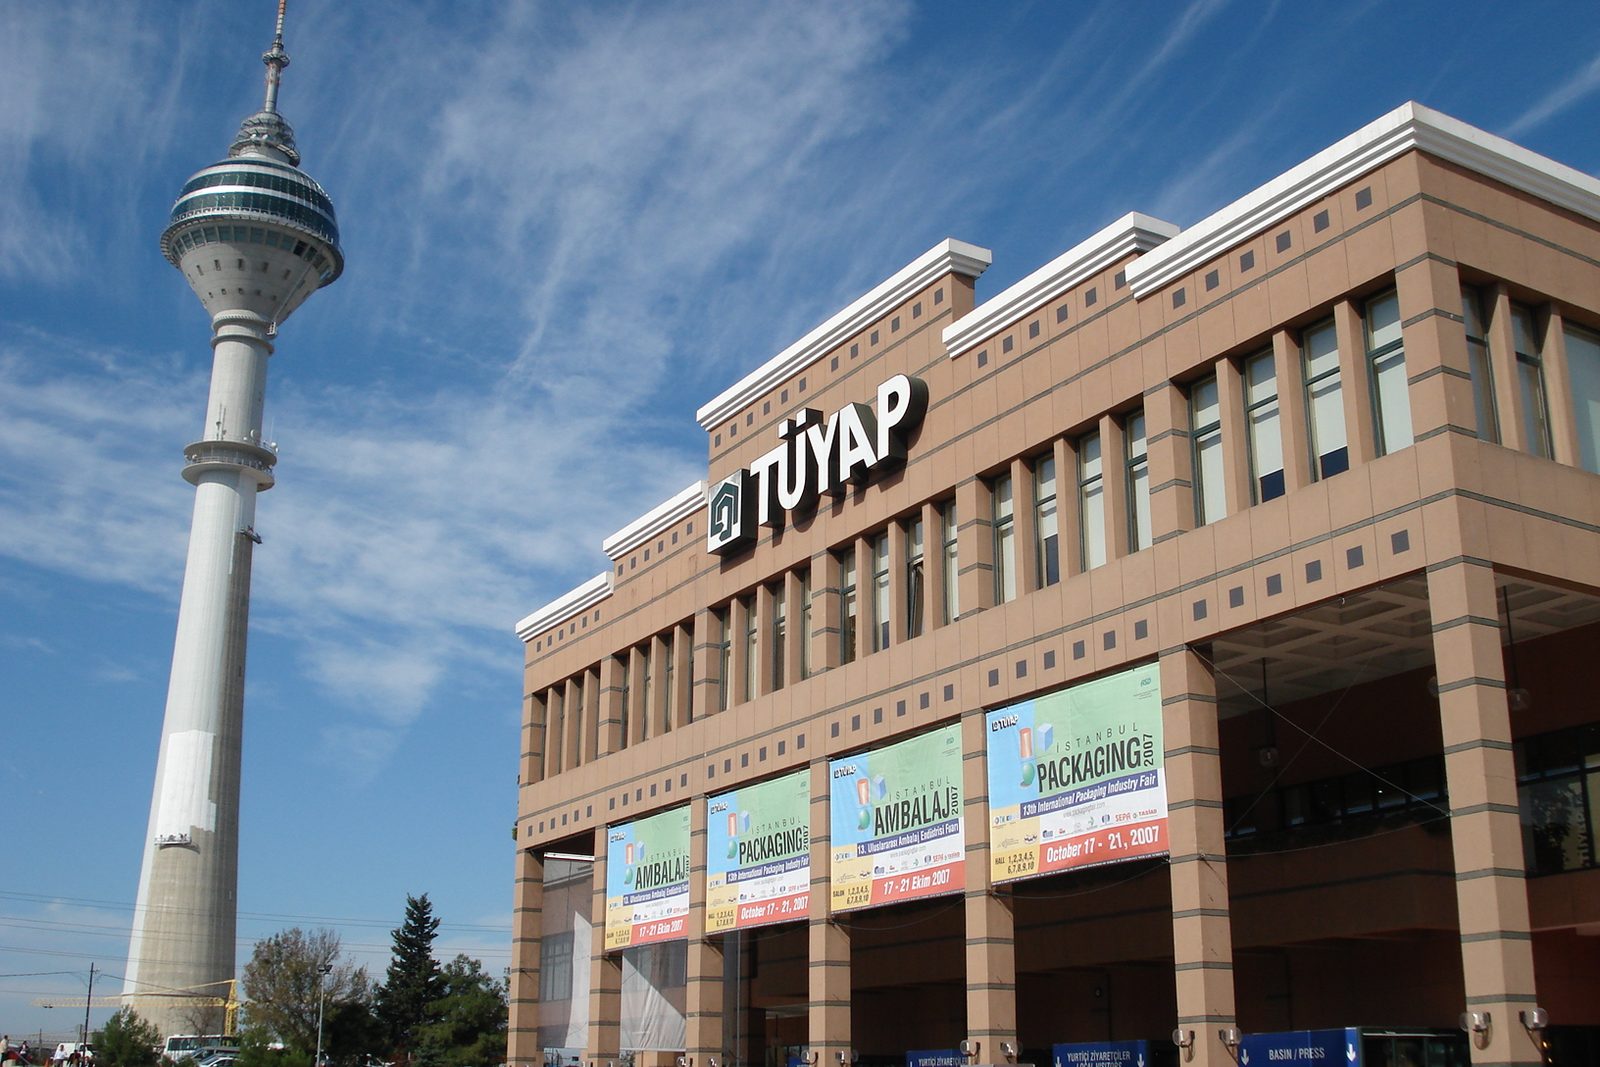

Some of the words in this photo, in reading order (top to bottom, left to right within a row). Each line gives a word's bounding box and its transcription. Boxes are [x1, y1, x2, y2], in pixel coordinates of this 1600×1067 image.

[750, 374, 914, 526] TÜYAP
[1037, 737, 1141, 792] PACKAGING
[1143, 733, 1154, 767] 2007
[951, 786, 959, 816] 2007
[1023, 802, 1037, 816] 13th
[1038, 793, 1075, 812] International
[1075, 786, 1107, 803] Packaging
[1107, 778, 1138, 793] Industry
[1139, 773, 1157, 787] Fair
[874, 787, 950, 837] AMBALAJ
[739, 827, 803, 865] PACKAGING
[898, 832, 920, 846] Ambalaj
[1046, 843, 1082, 863] October
[1084, 837, 1096, 854] 17
[1108, 832, 1128, 850] 21,
[1130, 825, 1160, 846] 2007
[635, 855, 686, 890] AMBALAJ
[884, 880, 893, 895] 17
[899, 878, 910, 893] 21
[911, 874, 931, 890] Ekim
[932, 869, 951, 887] 2007
[741, 905, 767, 920] October
[767, 902, 775, 915] 17
[793, 895, 809, 911] 2007
[640, 927, 646, 937] 17
[649, 925, 657, 936] 21
[657, 923, 671, 935] Ekim
[671, 919, 683, 932] 2007
[1269, 1048, 1292, 1060] BASIN
[1299, 1047, 1325, 1060] PRESS
